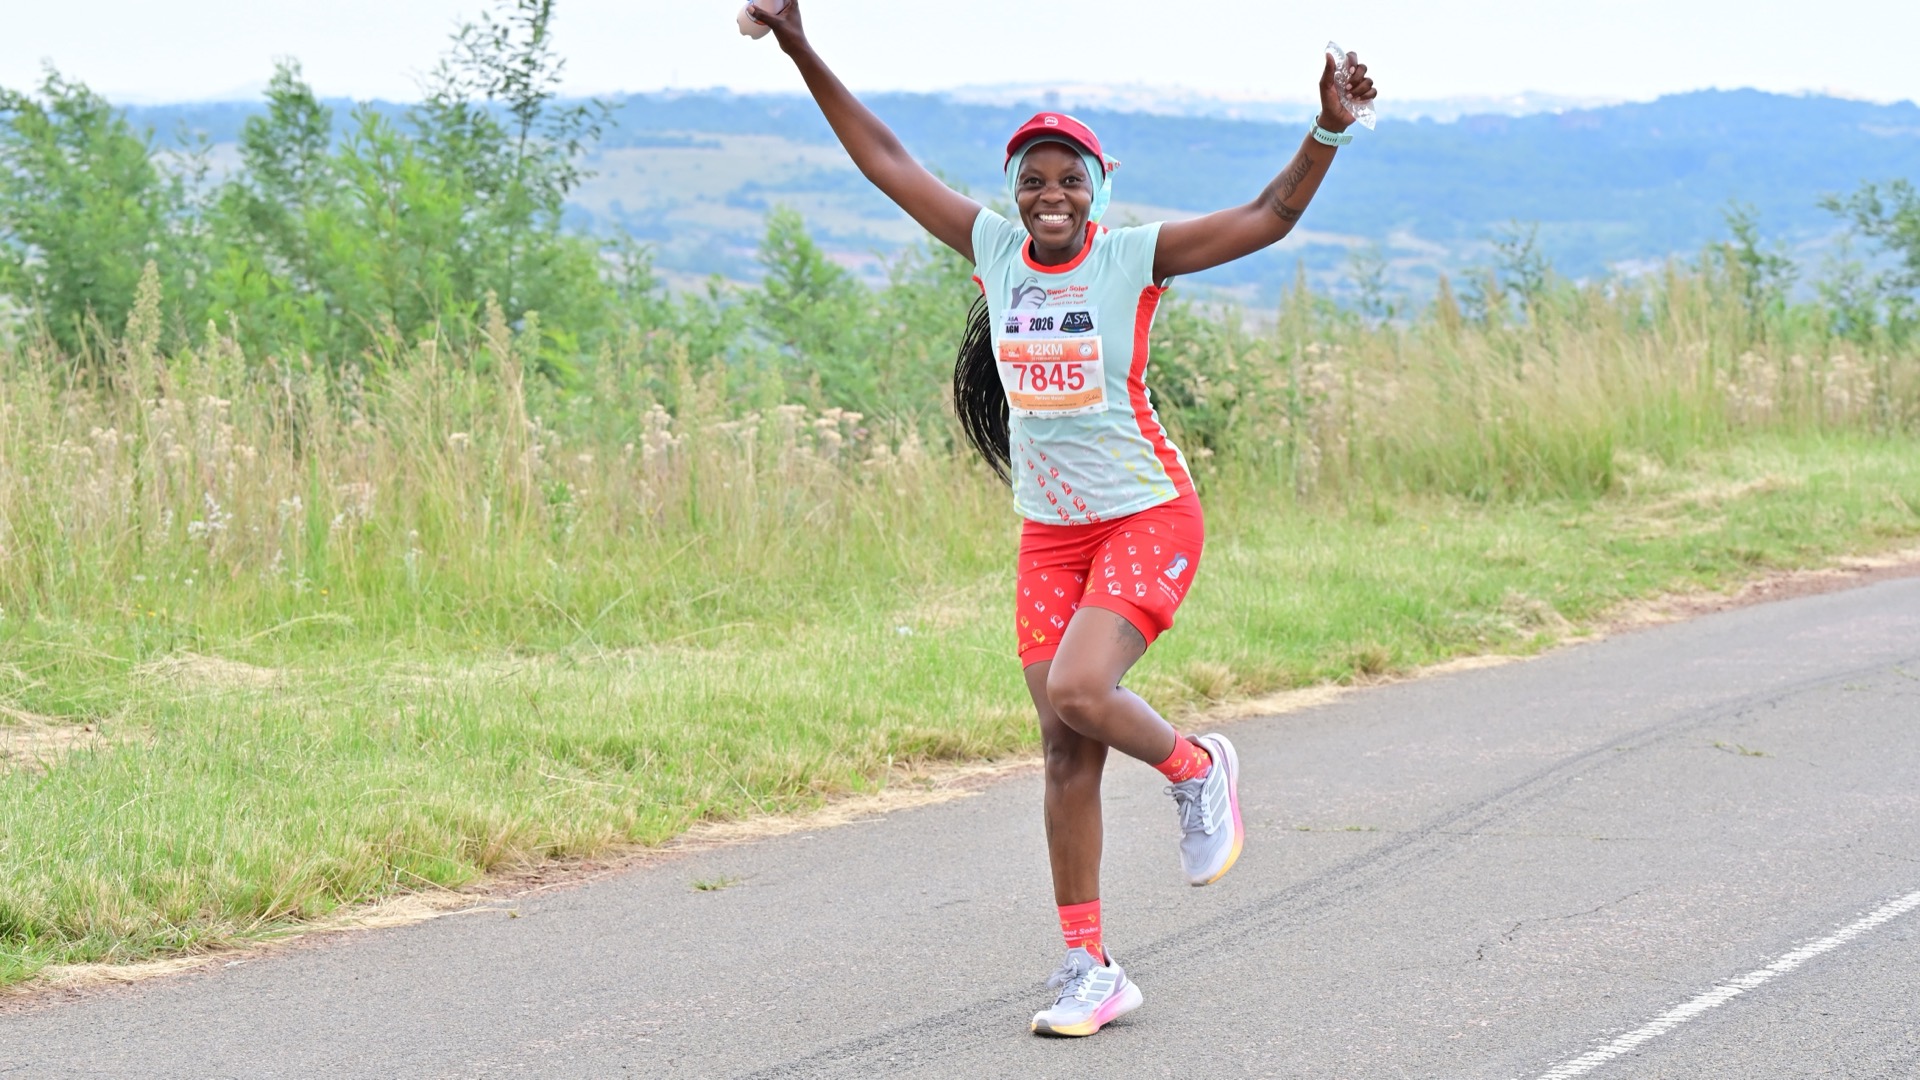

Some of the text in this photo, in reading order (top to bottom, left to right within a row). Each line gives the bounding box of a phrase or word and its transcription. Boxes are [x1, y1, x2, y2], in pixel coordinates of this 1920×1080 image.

[1283, 153, 1315, 200] Blessed
[1029, 316, 1053, 331] 2026
[1065, 313, 1089, 325] ASA
[1027, 343, 1062, 356] 42KM
[1013, 363, 1085, 391] 7845
